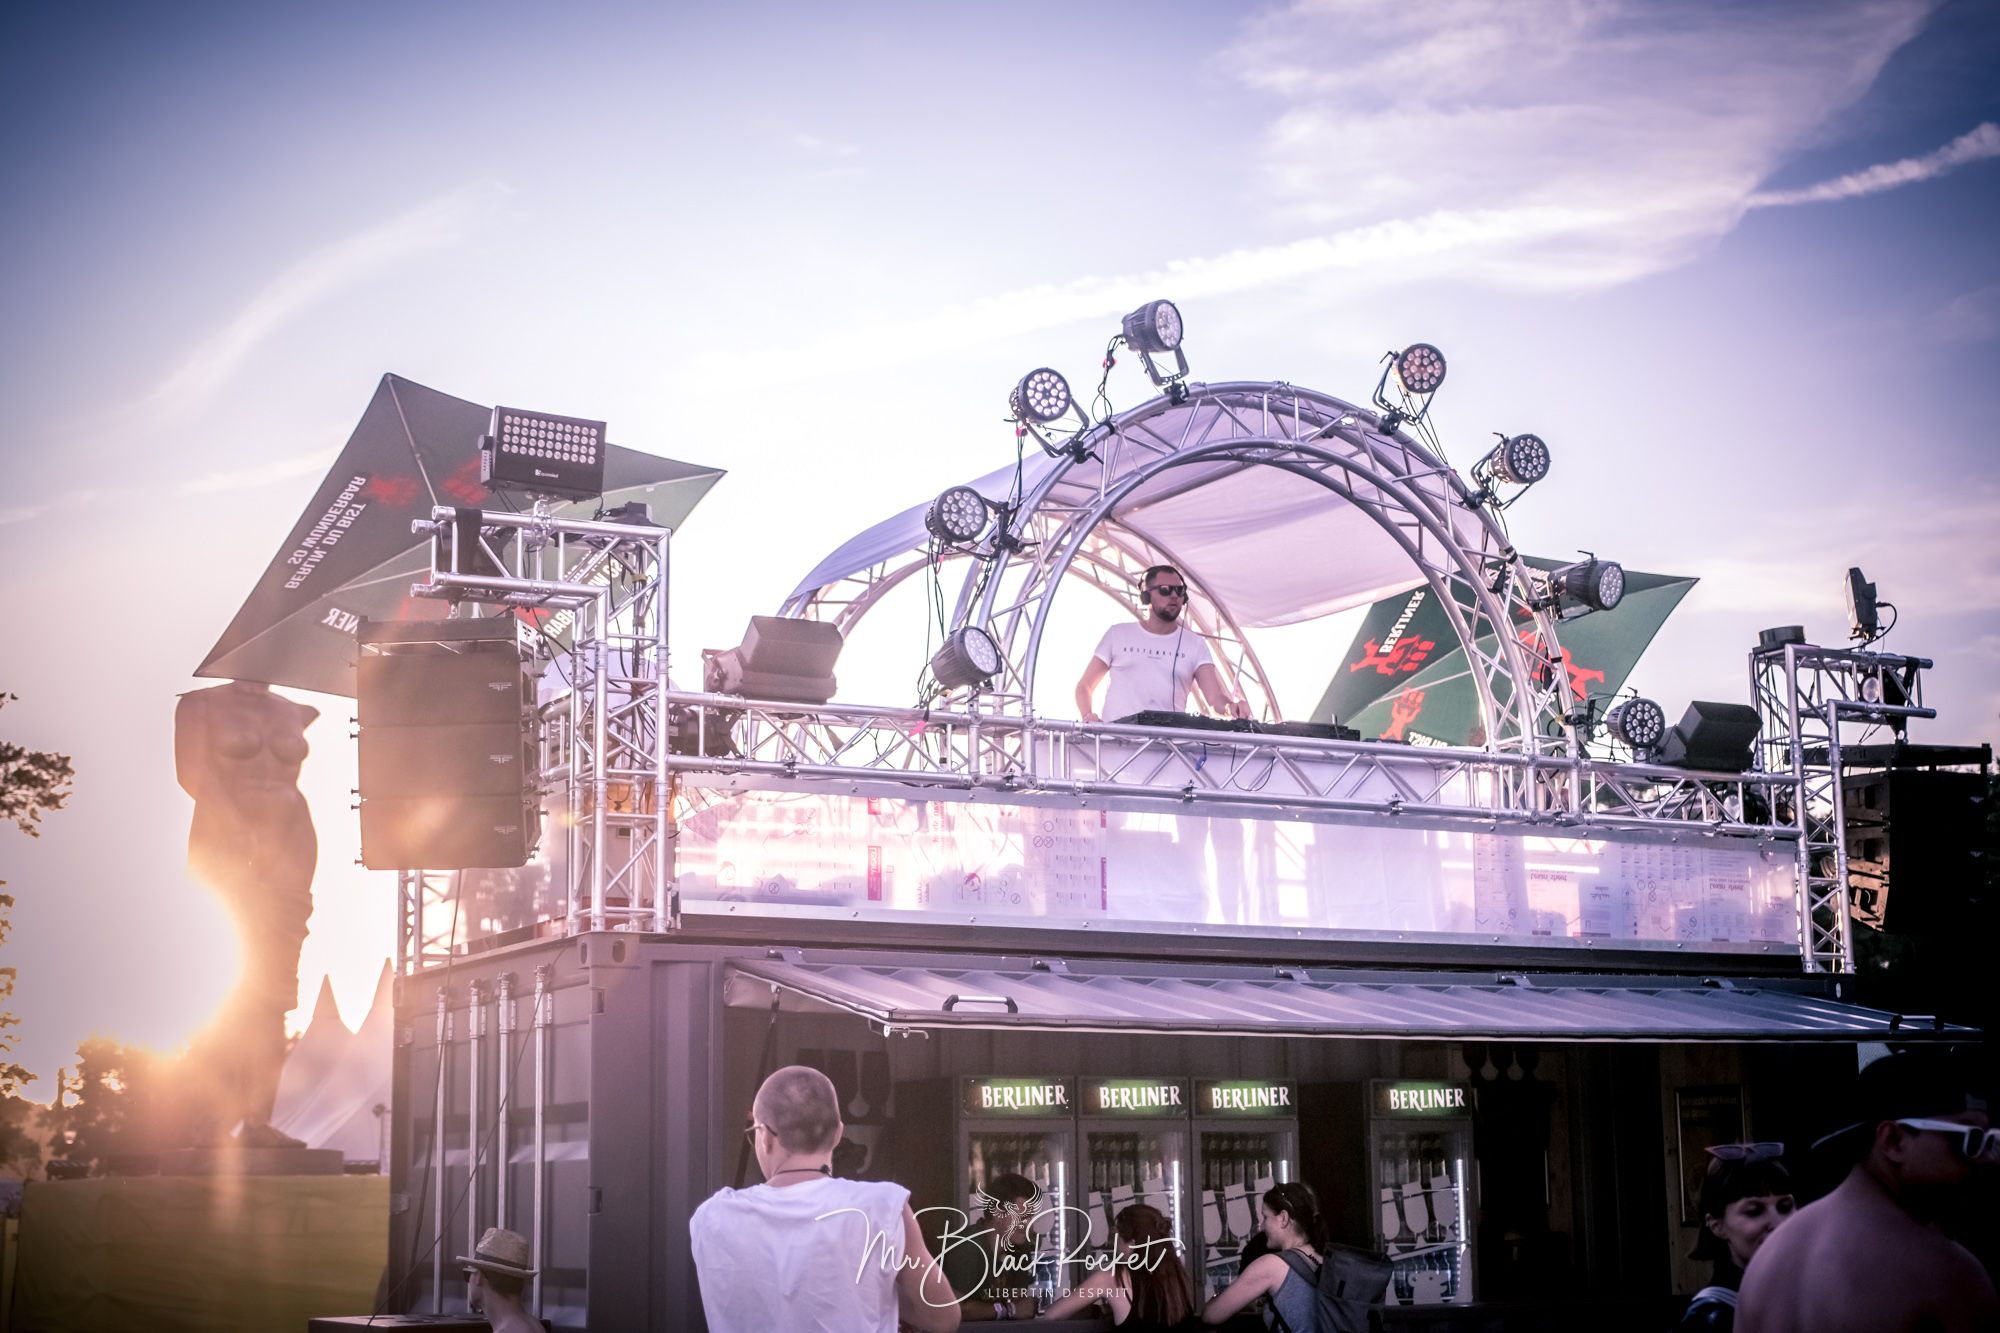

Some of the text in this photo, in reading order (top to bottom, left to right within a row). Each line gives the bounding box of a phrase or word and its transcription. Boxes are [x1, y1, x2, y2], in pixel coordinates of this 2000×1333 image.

[981, 1085, 1068, 1110] BERLINER
[1099, 1086, 1182, 1110] BERLINER
[1211, 1086, 1291, 1111] BERLINER
[1389, 1088, 1466, 1111] BERLINER
